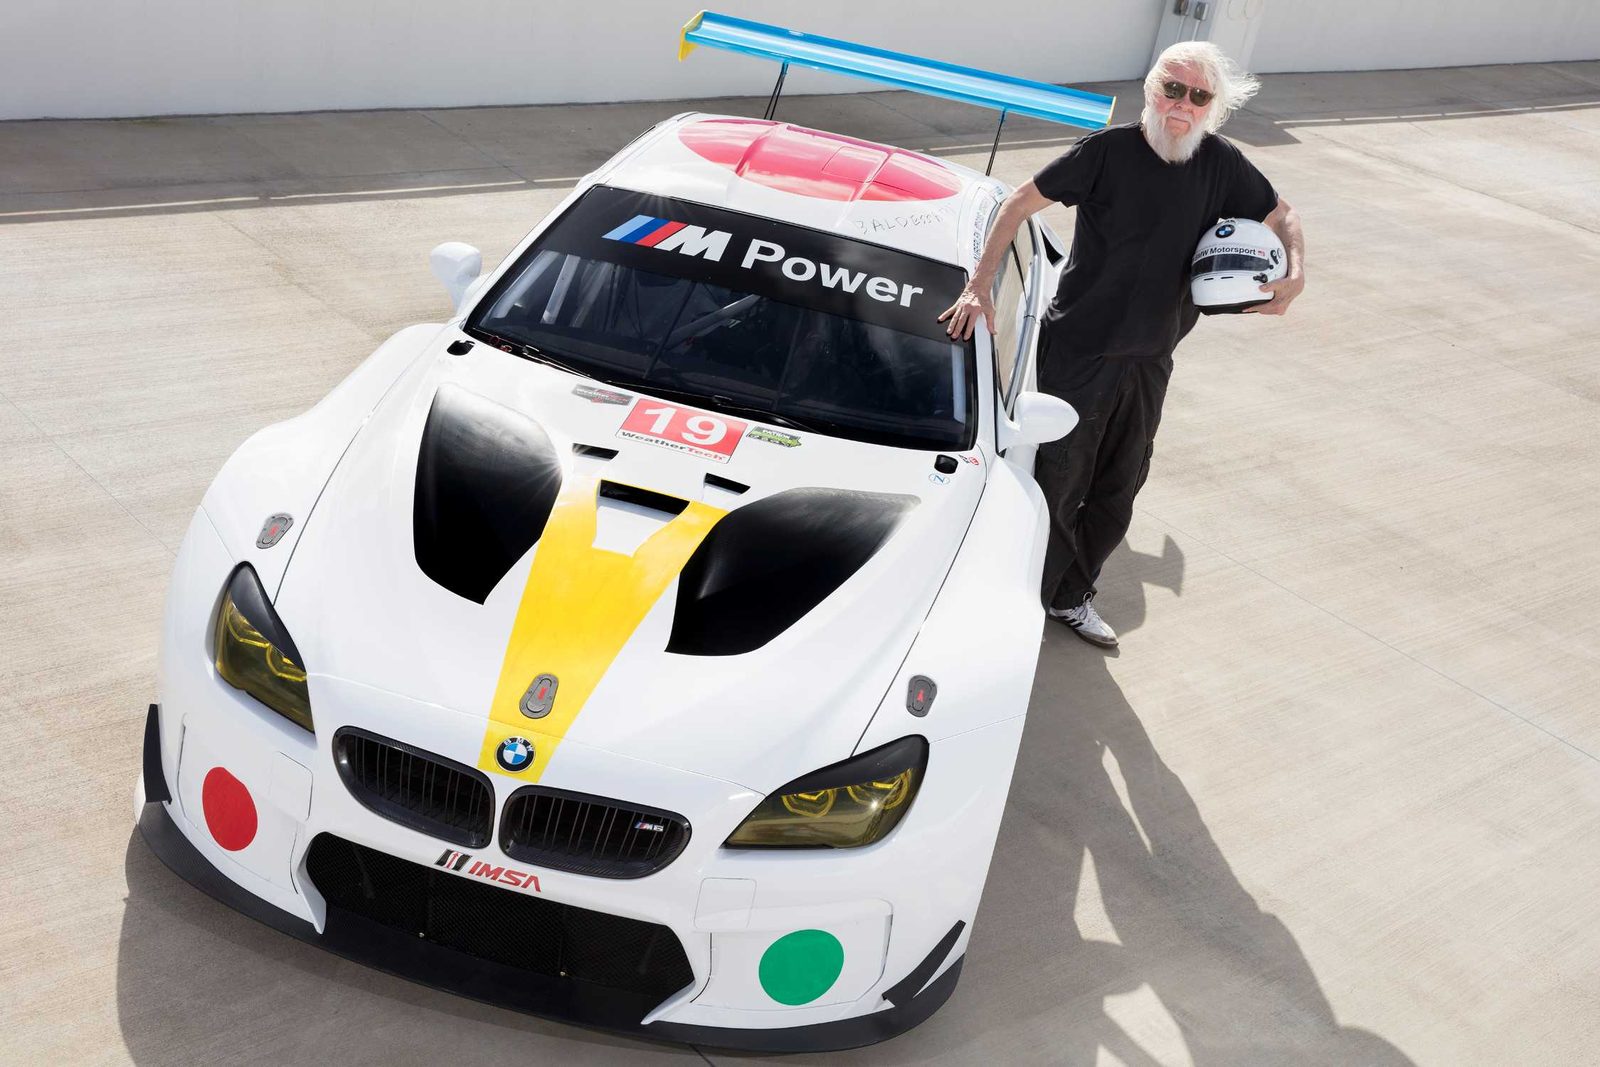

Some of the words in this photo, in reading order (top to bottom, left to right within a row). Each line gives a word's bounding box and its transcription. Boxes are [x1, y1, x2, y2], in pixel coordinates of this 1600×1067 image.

[653, 224, 732, 262] M
[741, 238, 924, 307] Power
[1210, 246, 1256, 255] Motorsport
[644, 406, 728, 446] 19
[622, 431, 725, 461] WeatherTech
[503, 737, 534, 752] BMW
[468, 860, 541, 892] IMSA
